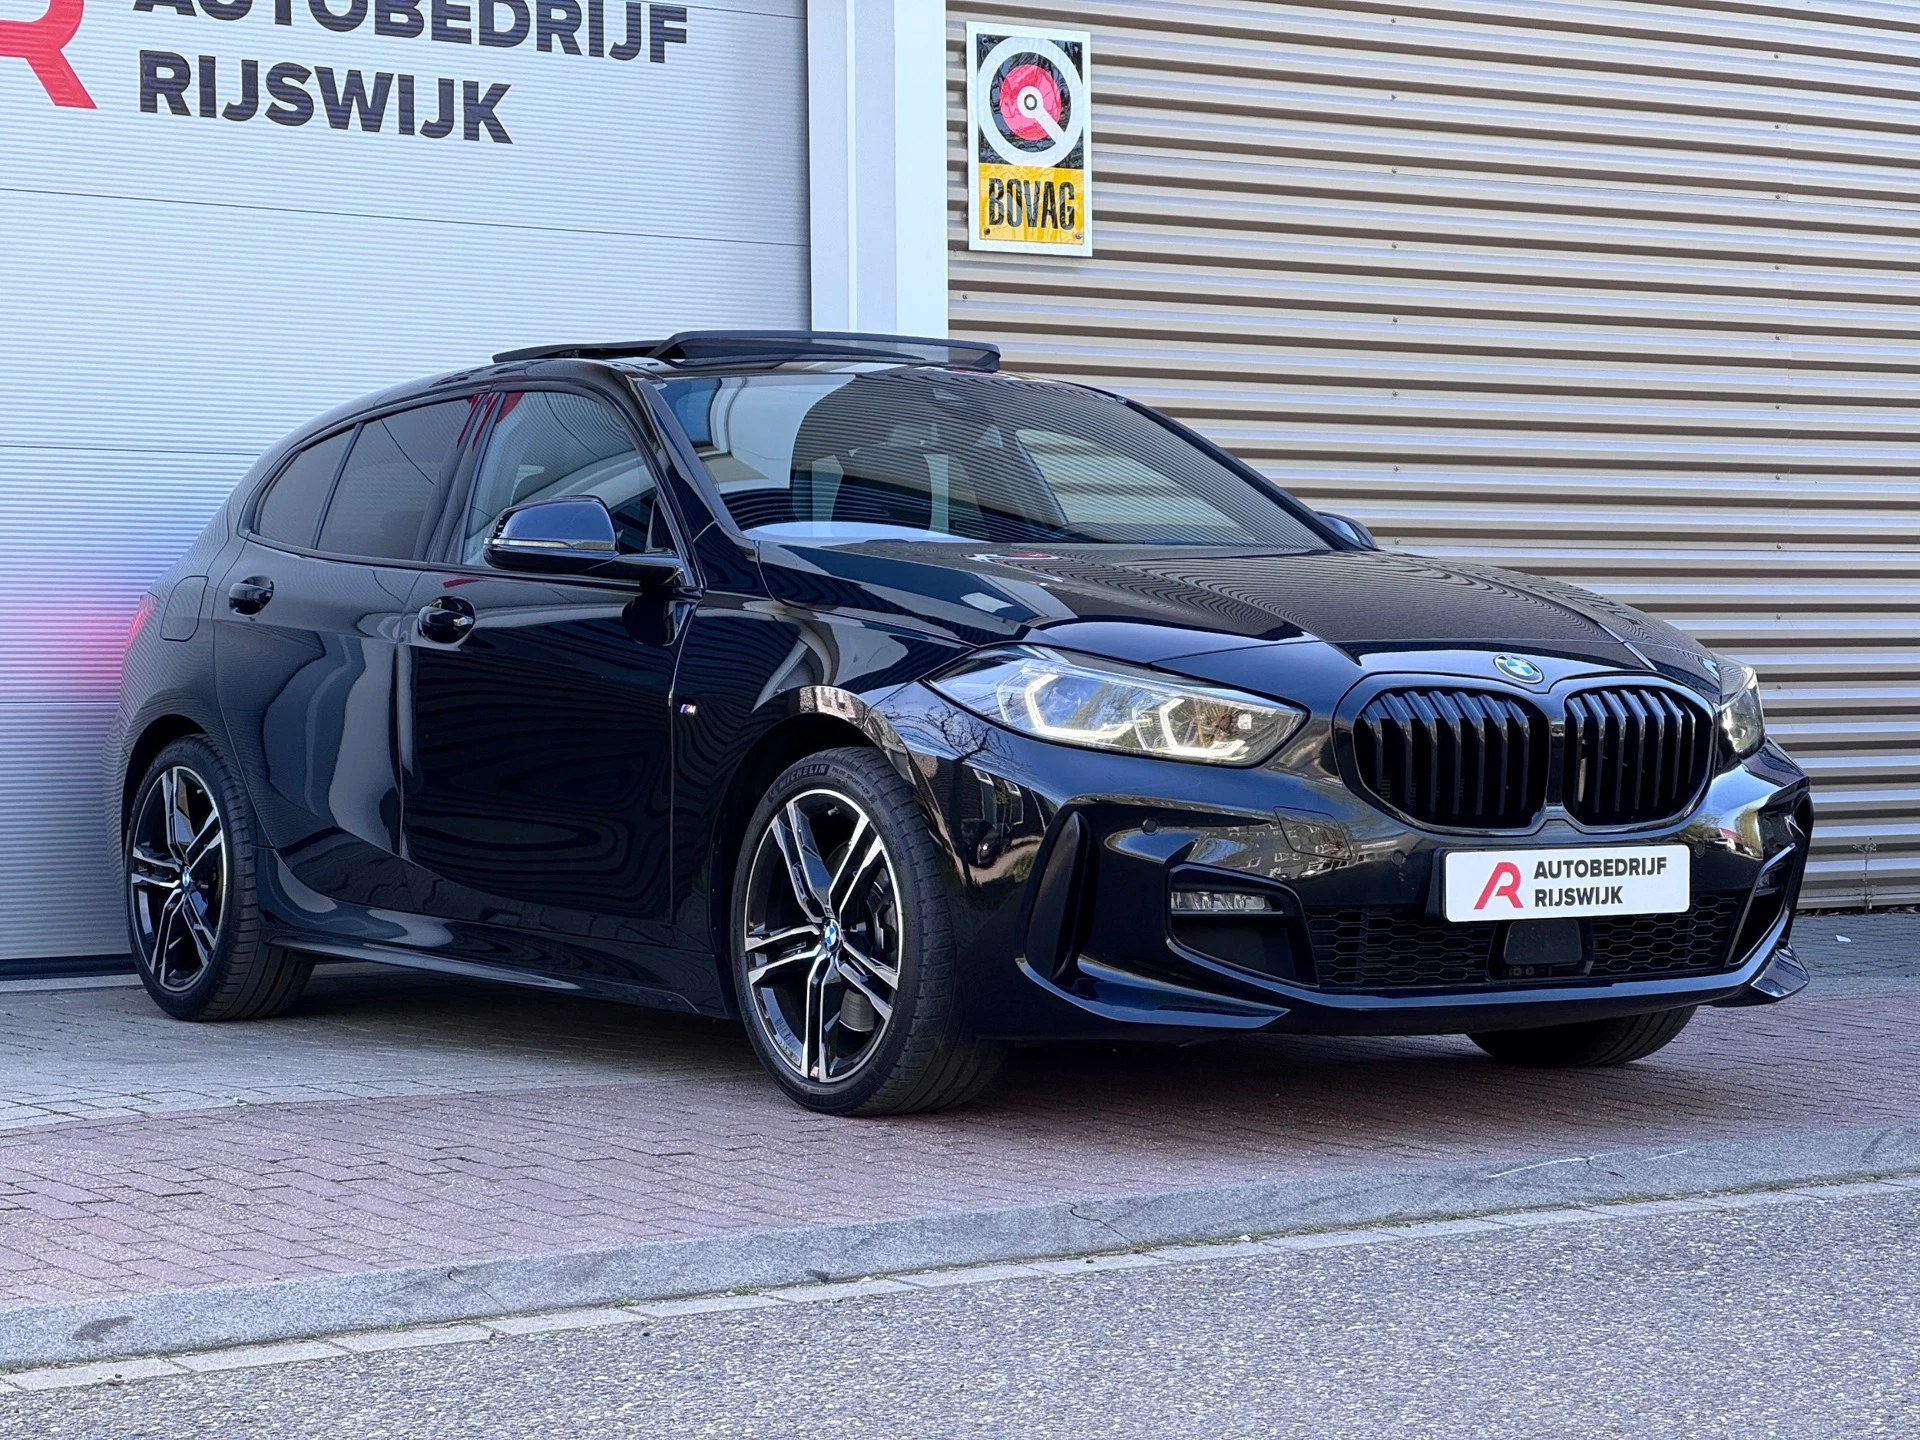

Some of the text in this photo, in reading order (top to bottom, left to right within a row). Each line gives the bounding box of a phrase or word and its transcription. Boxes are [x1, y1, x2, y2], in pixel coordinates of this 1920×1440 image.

[133, 0, 688, 63] OBEDRIJF
[139, 49, 513, 144] RIJSWIJK
[989, 178, 1075, 230] BOVAG
[779, 764, 827, 788] MICHELIN
[846, 773, 862, 787] SPORT
[1533, 856, 1668, 879] AUTOBEDRIJF
[1534, 886, 1624, 908] RIJSWIJK
